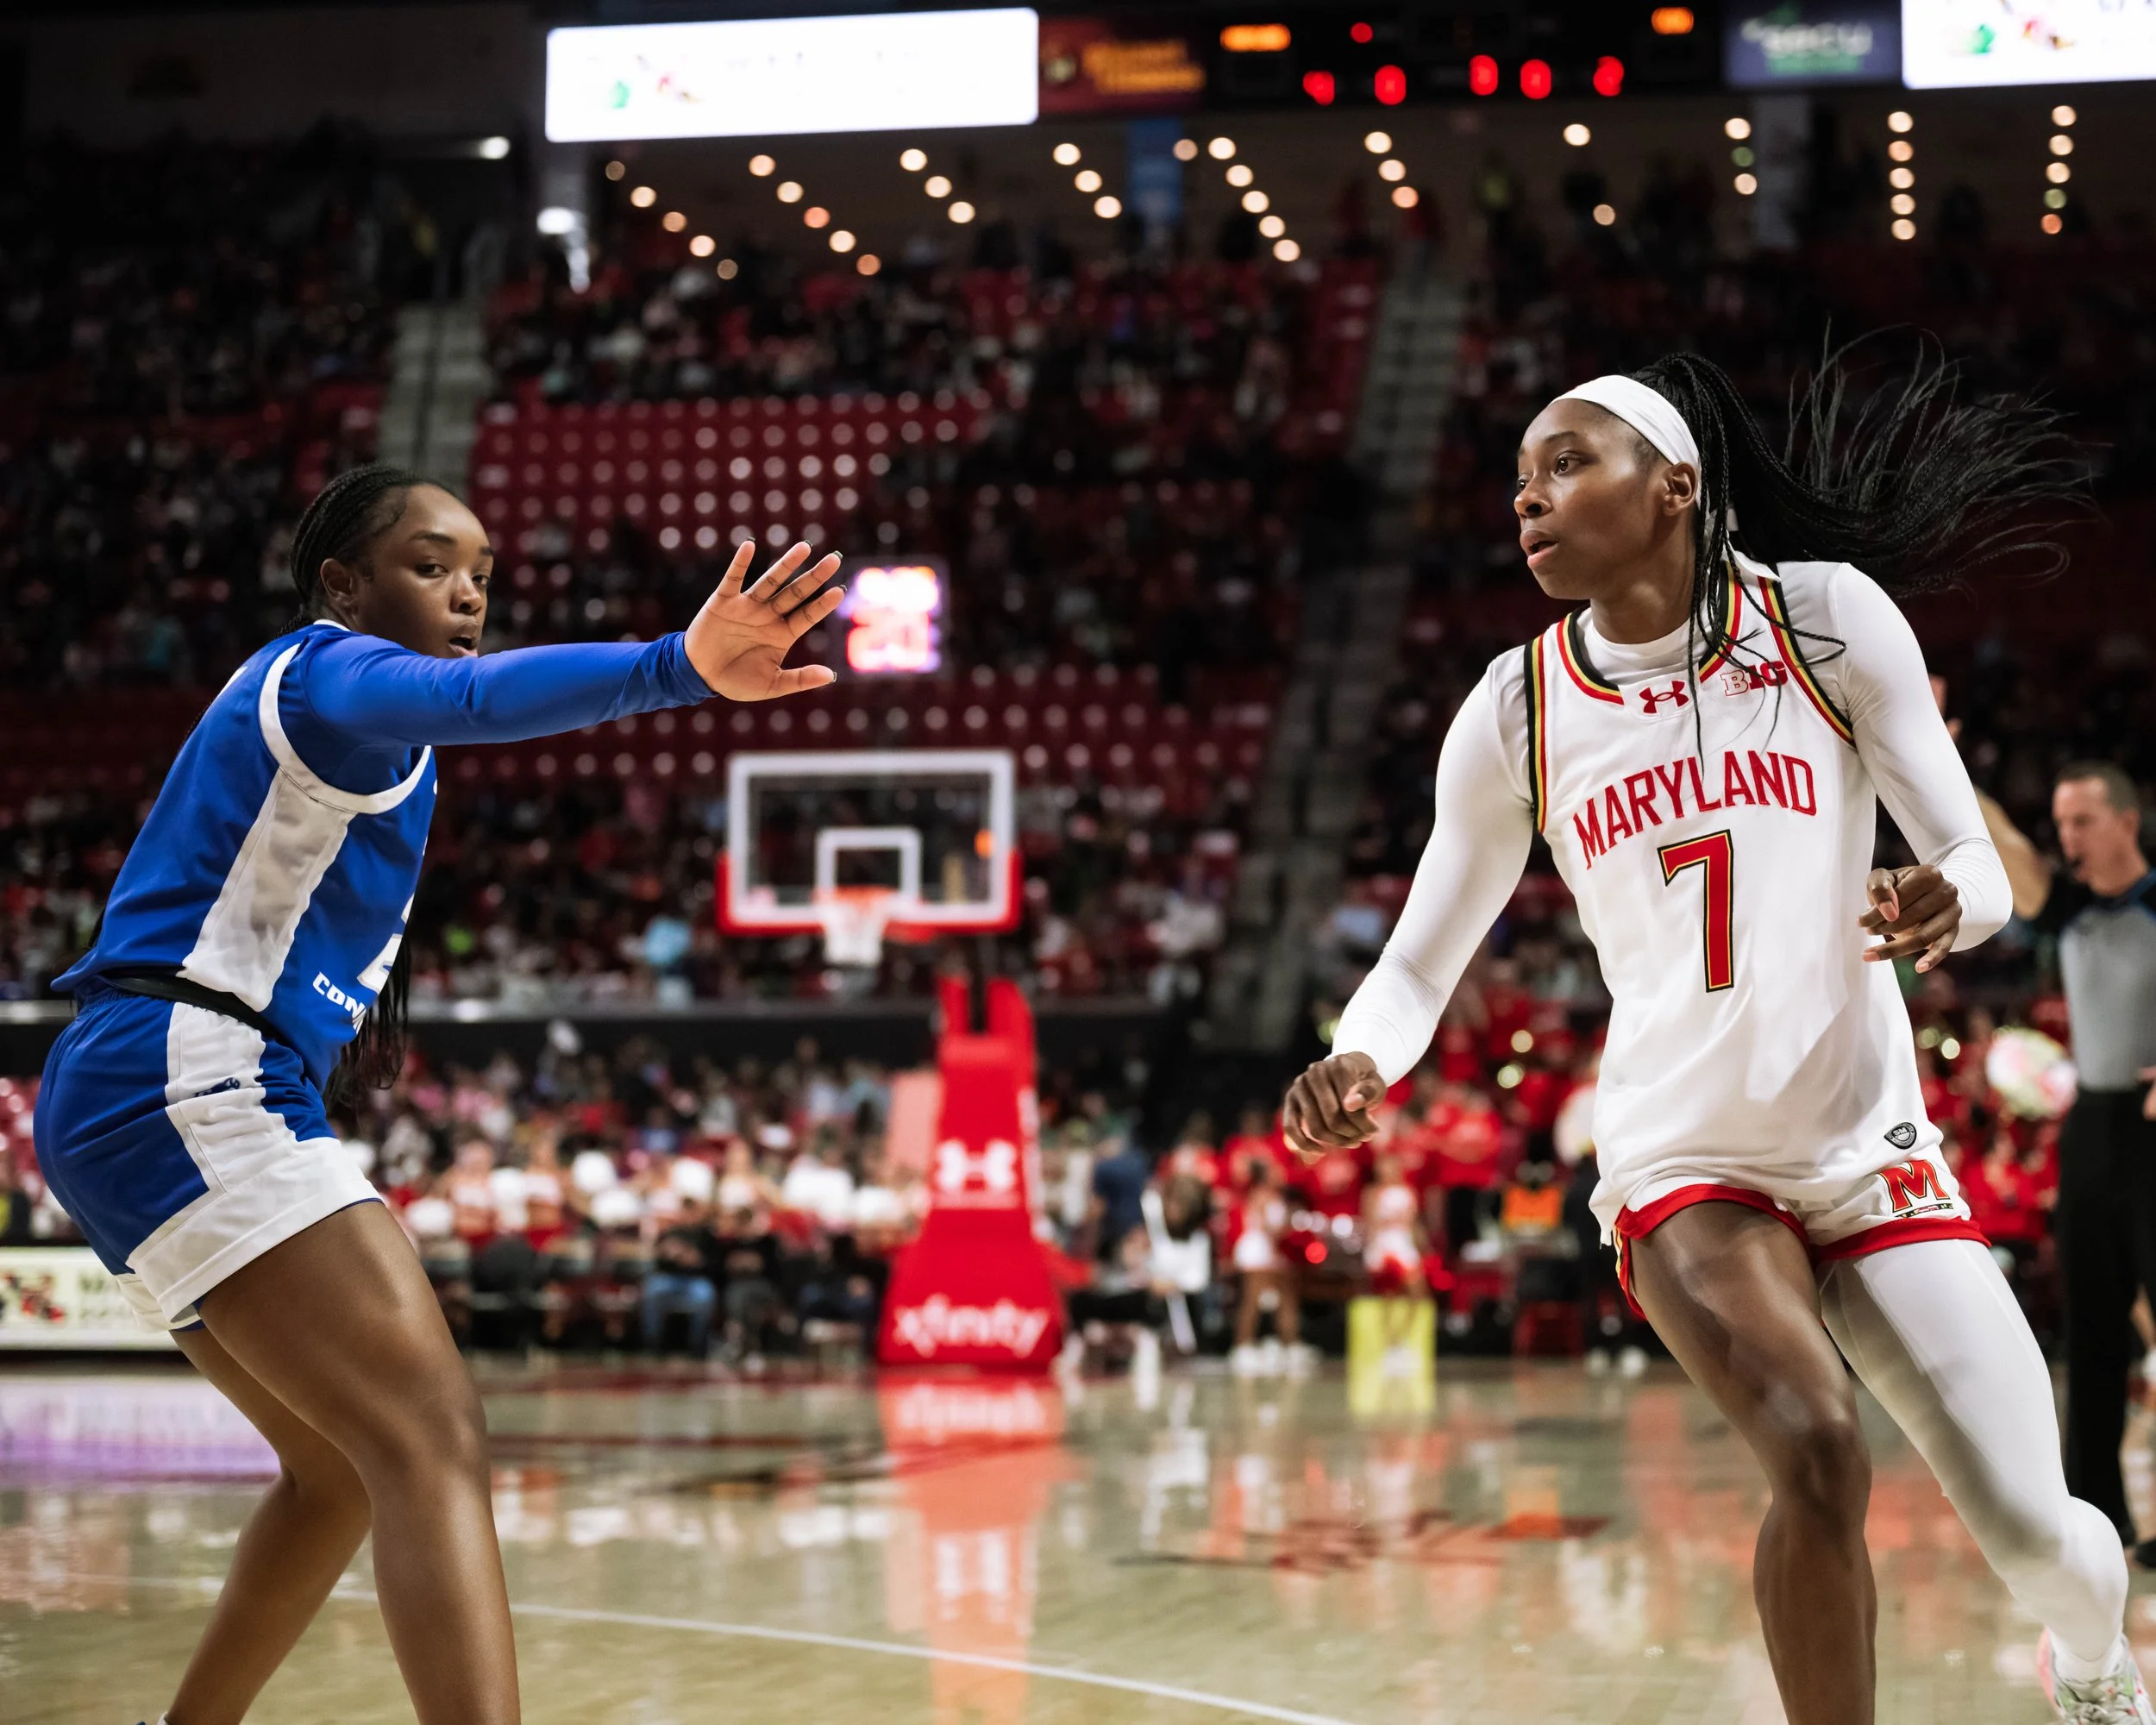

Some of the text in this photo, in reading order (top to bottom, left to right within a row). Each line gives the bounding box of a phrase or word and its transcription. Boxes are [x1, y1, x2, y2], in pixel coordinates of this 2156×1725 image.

[1573, 750, 1817, 869] MARYLAND
[1658, 829, 1734, 993] 7
[312, 971, 367, 1035] CON
[1876, 1158, 1951, 1213] M
